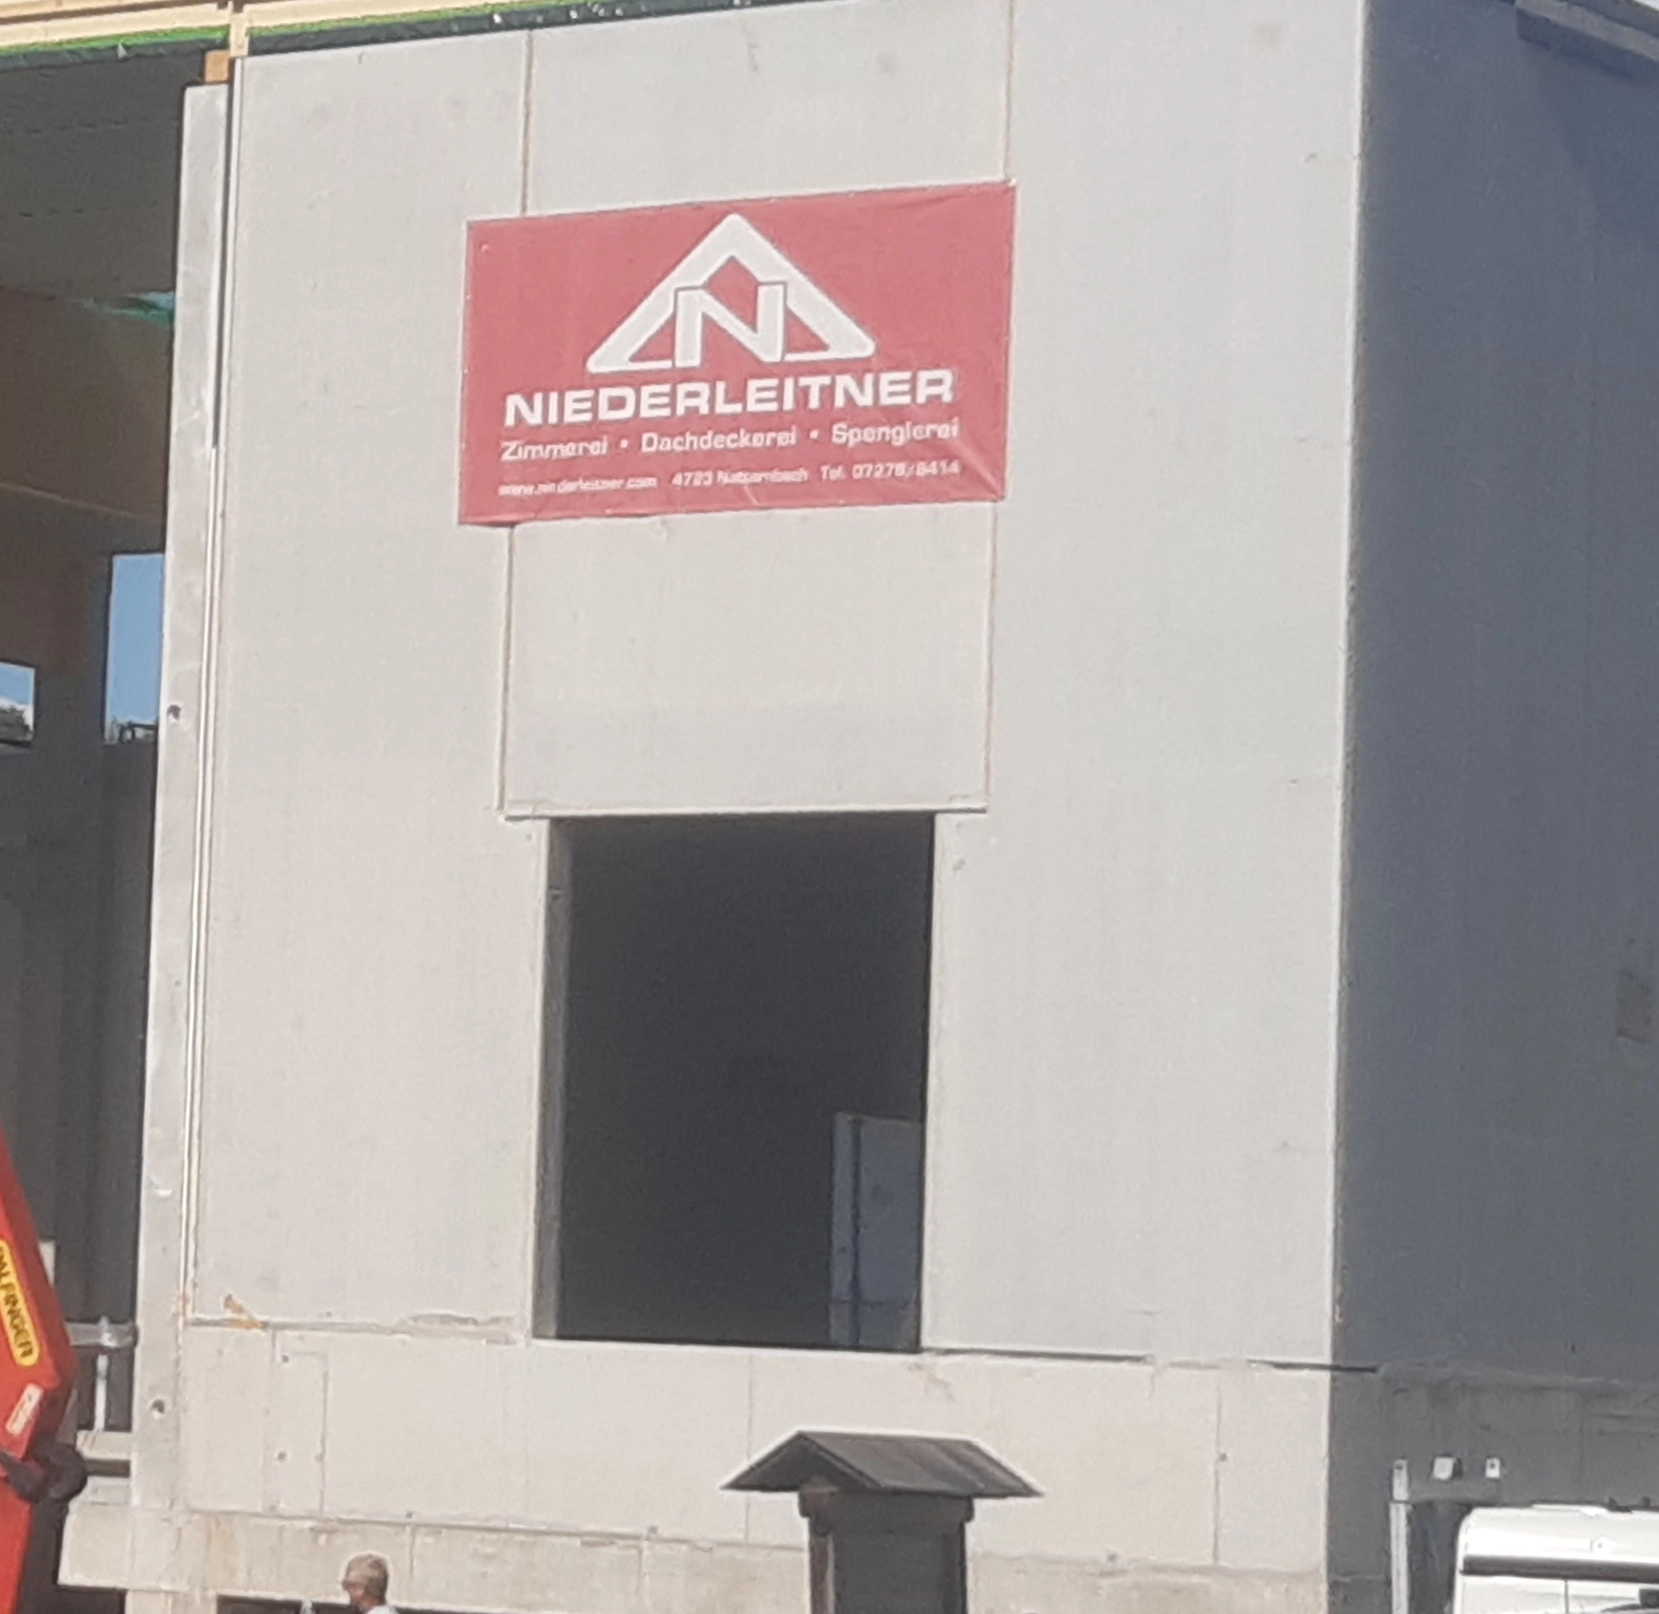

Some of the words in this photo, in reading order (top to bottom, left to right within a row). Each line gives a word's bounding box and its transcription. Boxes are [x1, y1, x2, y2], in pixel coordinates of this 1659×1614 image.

[504, 368, 956, 427] NIEDERLEITNER
[500, 434, 608, 461] Zimmerei
[641, 424, 797, 452] Dachdeckerei
[831, 416, 960, 448] Spenglerei
